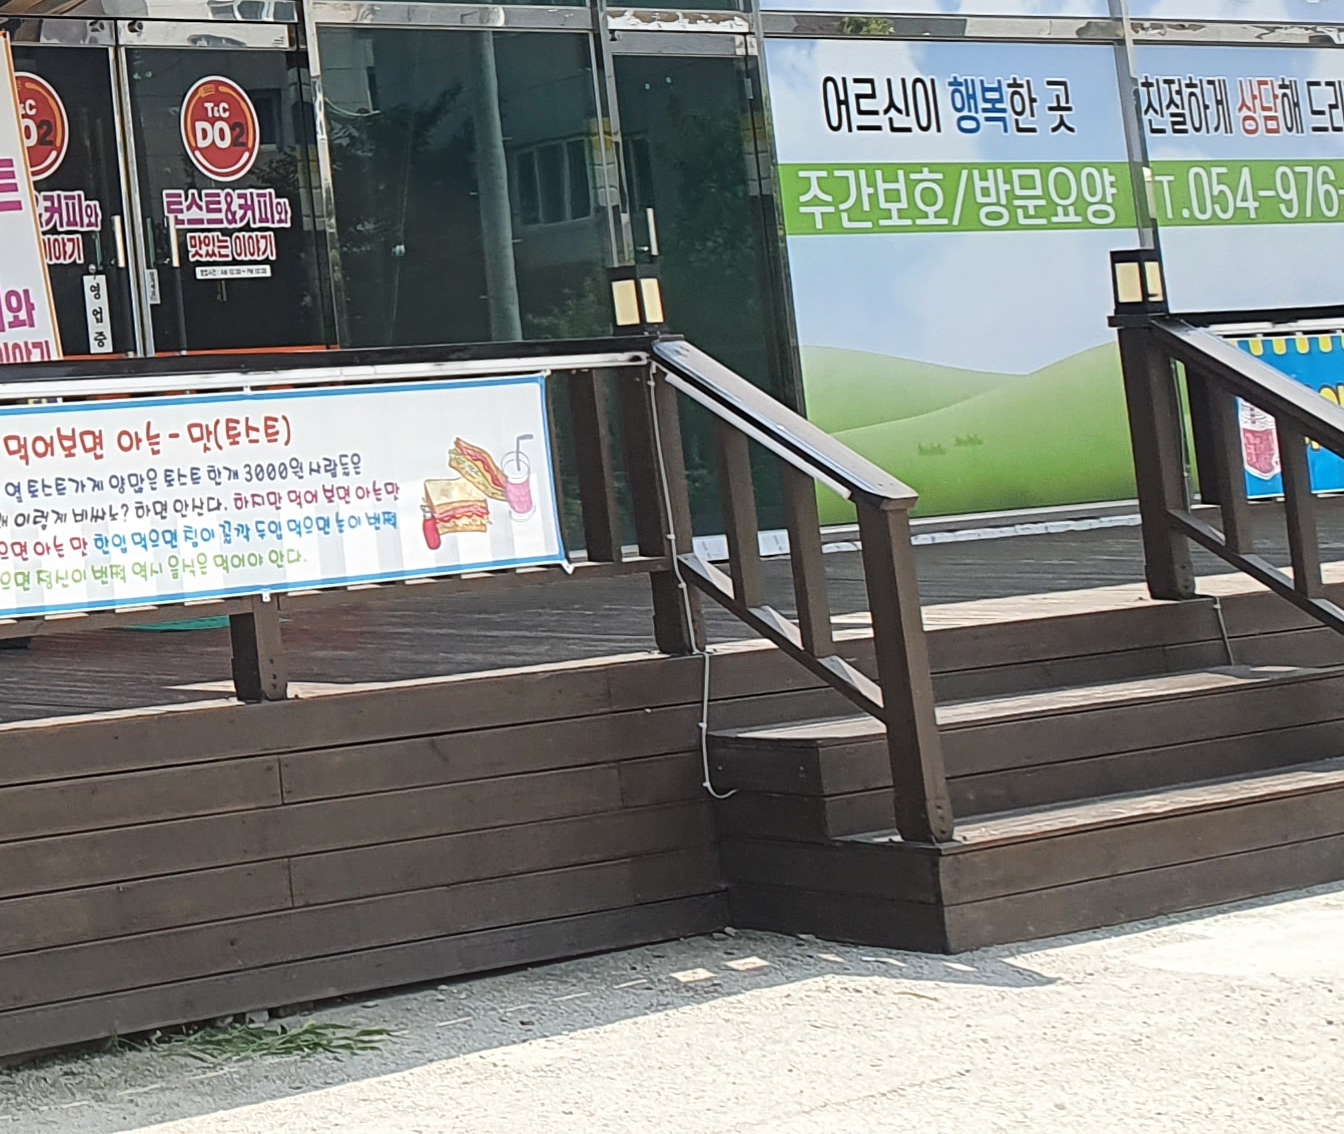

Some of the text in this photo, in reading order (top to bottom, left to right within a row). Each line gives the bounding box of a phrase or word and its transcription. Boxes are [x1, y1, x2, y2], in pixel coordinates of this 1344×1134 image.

[204, 102, 230, 118] T&C
[822, 76, 1076, 134] 어르신이 행복한 곳
[1140, 75, 1234, 134] 친절하게
[1238, 77, 1305, 135] 상담해
[21, 117, 54, 147] O2
[194, 120, 247, 149] DO2
[165, 190, 289, 226] 토스트&커피와
[798, 166, 1118, 229] 주간보호/방문요양
[189, 233, 274, 259] 맛있는 이야기
[3, 427, 104, 466] 먹어보면
[117, 421, 160, 455] 아는
[4, 481, 23, 503] 옆
[164, 467, 201, 487] 토스트
[207, 465, 239, 486] 한개
[243, 457, 304, 483] 3000원
[308, 453, 361, 478] 사람들은
[134, 500, 168, 520] 하면
[233, 491, 283, 511] 하지만
[93, 533, 127, 555] 한입
[131, 528, 179, 552] 먹으면
[183, 525, 216, 548] 침이
[287, 516, 330, 538] 먹으면
[35, 568, 87, 590] 정신이
[132, 561, 163, 582] 역시
[167, 552, 208, 580] 음식은
[213, 552, 264, 574] 먹어야
